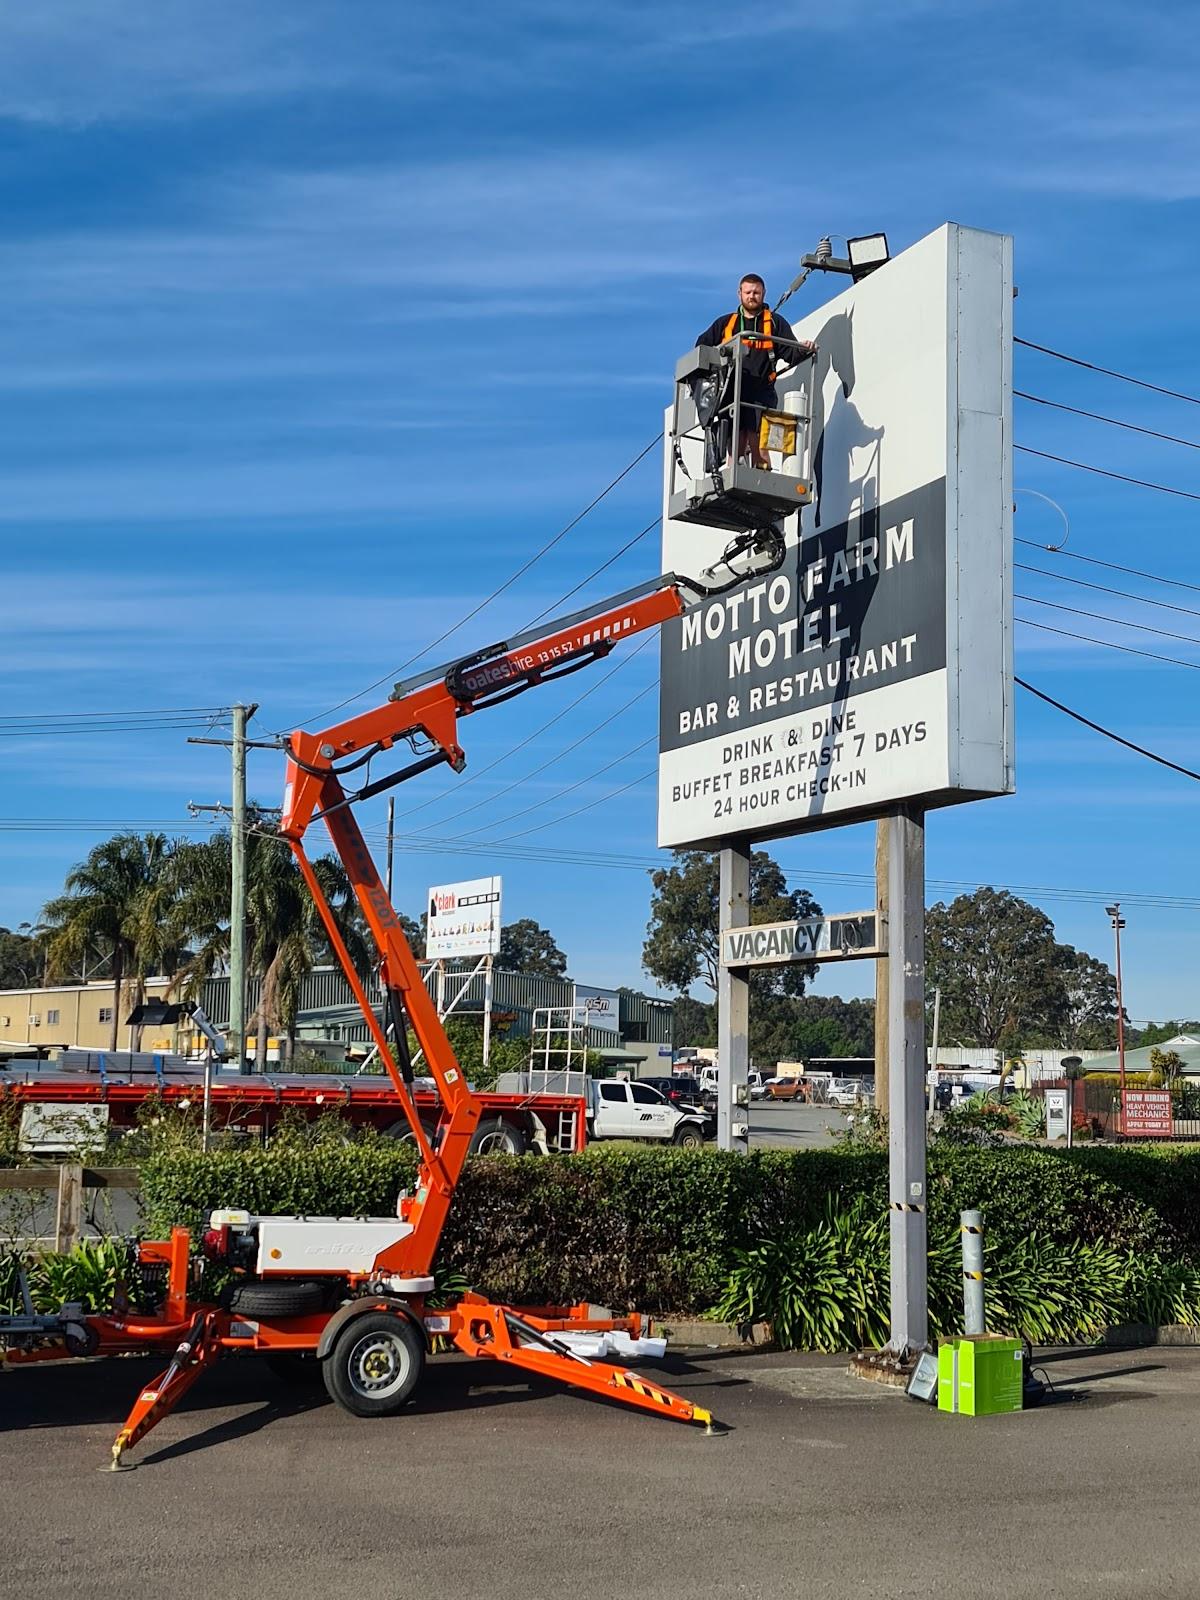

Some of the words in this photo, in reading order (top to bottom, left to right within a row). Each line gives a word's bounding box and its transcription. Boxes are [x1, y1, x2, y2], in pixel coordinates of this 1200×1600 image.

[681, 574, 791, 651] MOTTO
[804, 518, 915, 603] FARM
[462, 655, 534, 692] oateshire
[537, 652, 549, 663] 13
[549, 647, 561, 659] 15
[562, 641, 574, 653] 52
[728, 603, 850, 679] MOTEL
[679, 702, 718, 735] BAR
[727, 695, 740, 718] &
[749, 633, 917, 713] RESTAURANT
[672, 773, 732, 802] BUFFET
[739, 742, 845, 786] BREAKFAST
[853, 733, 866, 757] 7
[875, 721, 927, 753] DAYS
[723, 734, 773, 765] DRINK
[787, 728, 799, 746] &
[812, 710, 857, 741] DINE
[713, 796, 733, 818] 24
[739, 789, 780, 813] HOUR
[786, 768, 866, 801] CHECK-IN
[438, 892, 456, 910] clark
[729, 923, 823, 959] VACANCY
[1126, 1094, 1142, 1102] NOW
[1145, 1094, 1169, 1102] HIRING
[1126, 1110, 1169, 1118] MECHANICS
